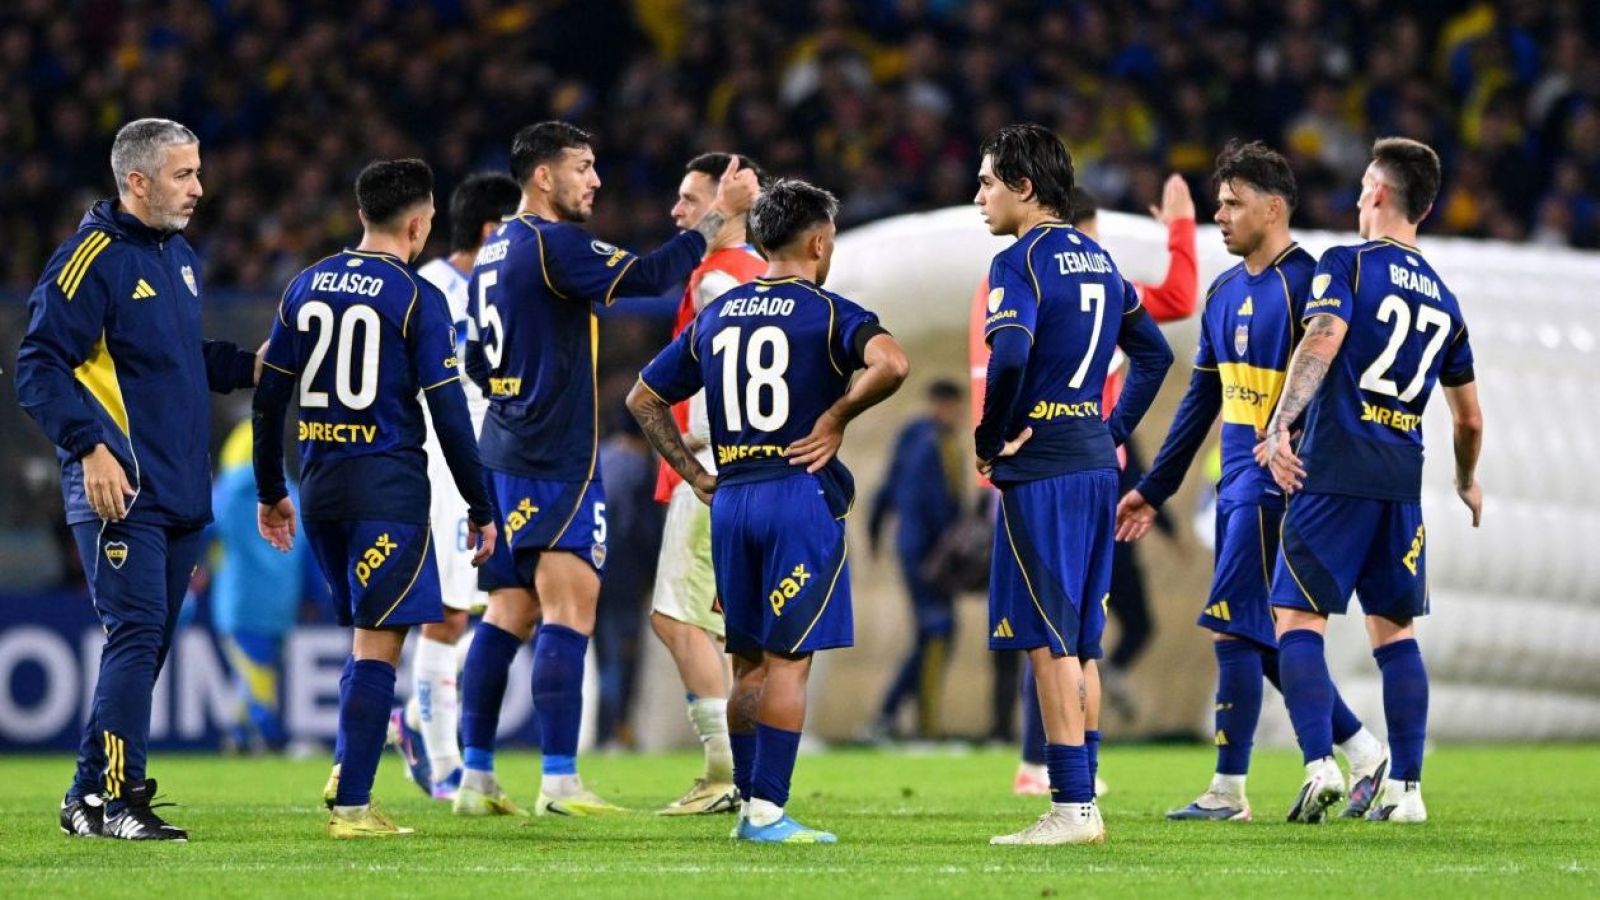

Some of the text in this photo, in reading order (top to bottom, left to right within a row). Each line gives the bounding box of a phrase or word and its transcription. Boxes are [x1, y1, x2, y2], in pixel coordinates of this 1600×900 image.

[311, 272, 384, 297] VELASCO
[1054, 251, 1113, 275] ZEBALLOS
[1389, 264, 1442, 301] BRAIDA
[478, 270, 503, 369] 5
[719, 297, 795, 317] DELGADO
[297, 300, 381, 411] 20
[1068, 283, 1106, 389] 7
[1359, 294, 1452, 403] 27
[712, 325, 790, 432] 18
[298, 421, 377, 443] DIRECTV
[592, 502, 607, 543] 5
[354, 533, 398, 588] pax
[769, 563, 811, 617] pax
